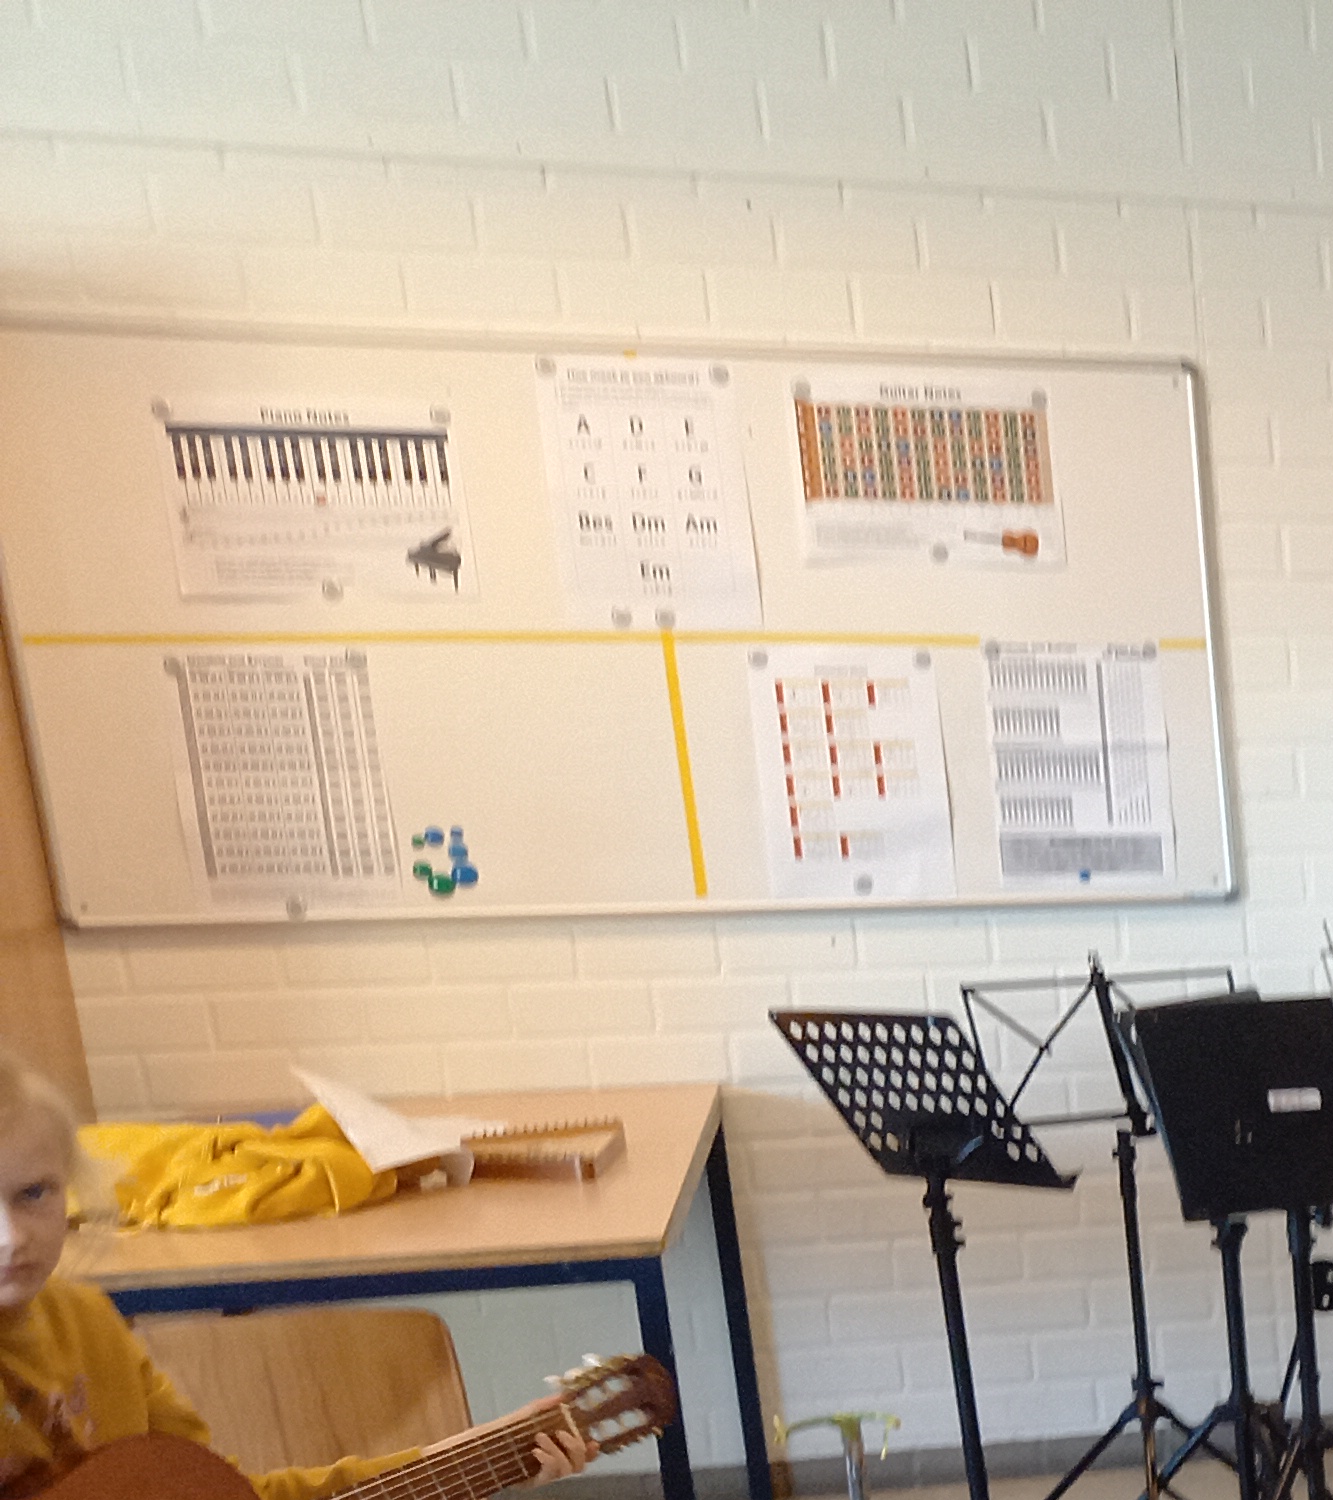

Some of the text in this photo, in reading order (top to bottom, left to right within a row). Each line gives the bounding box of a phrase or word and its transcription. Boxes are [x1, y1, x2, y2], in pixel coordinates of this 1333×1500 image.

[260, 407, 350, 425] Piano Notes
[577, 413, 592, 436] A
[630, 414, 644, 436] D
[631, 511, 667, 534] Dm
[685, 512, 718, 535] Am
[639, 558, 672, 583] Em
